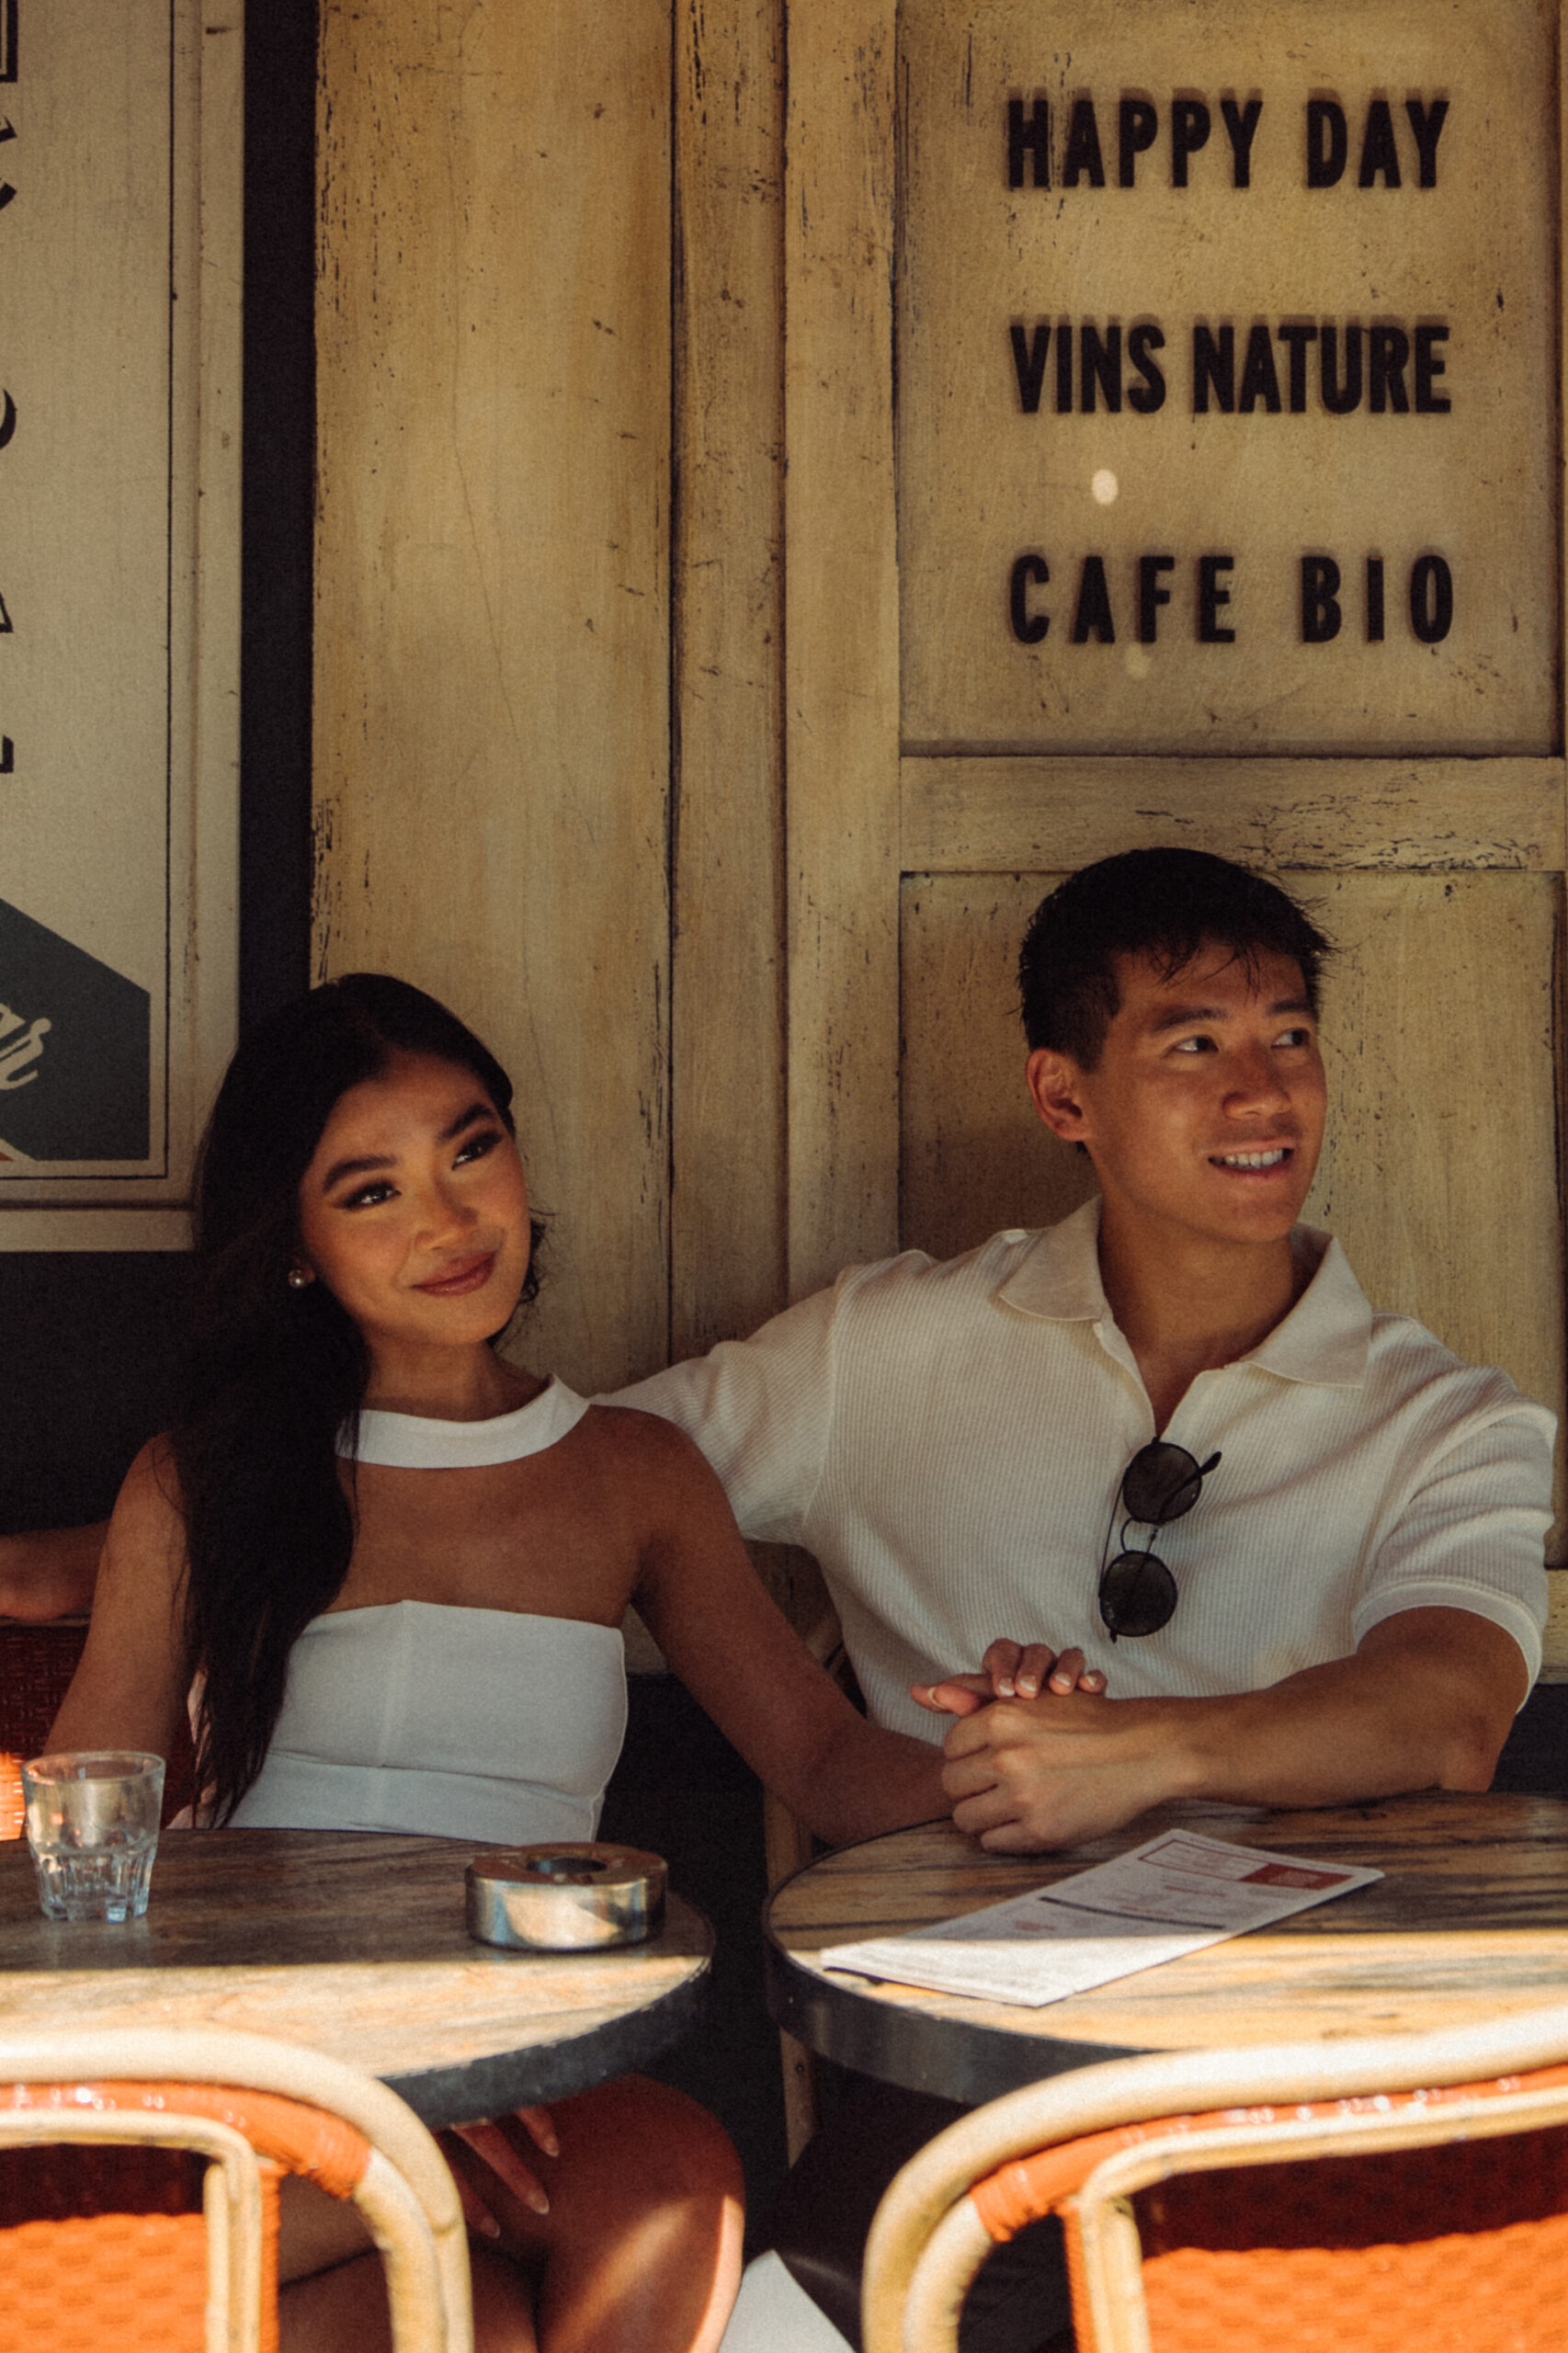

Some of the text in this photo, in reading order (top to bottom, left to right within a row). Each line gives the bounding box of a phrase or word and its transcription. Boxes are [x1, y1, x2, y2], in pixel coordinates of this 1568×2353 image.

[1006, 96, 1449, 188] HAPPY DAY
[1009, 323, 1451, 414] VINS NATURE
[1008, 553, 1453, 644] CAFE BIO
